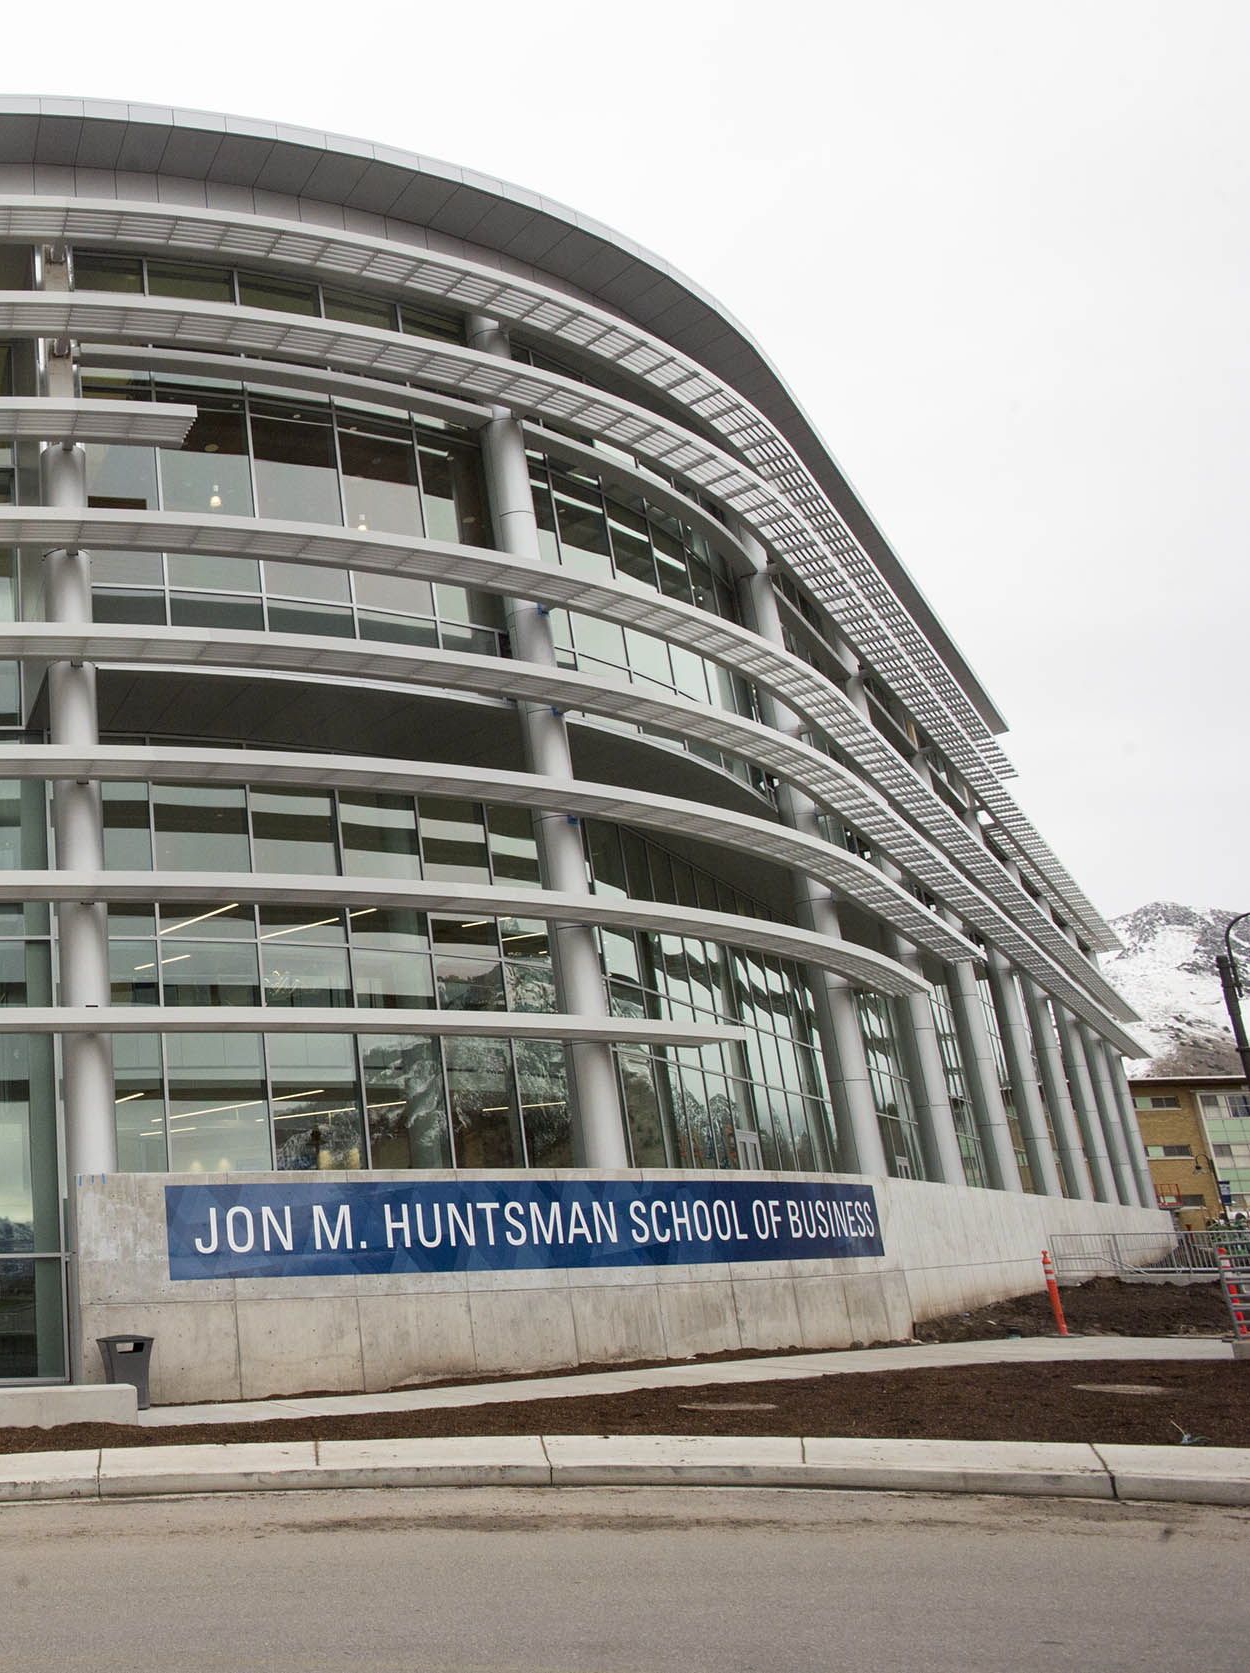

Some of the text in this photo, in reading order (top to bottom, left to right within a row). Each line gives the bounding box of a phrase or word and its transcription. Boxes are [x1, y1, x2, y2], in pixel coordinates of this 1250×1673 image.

[194, 1199, 875, 1254] JON M. HUNTSMAN SCHOOL OF BUSINESS
